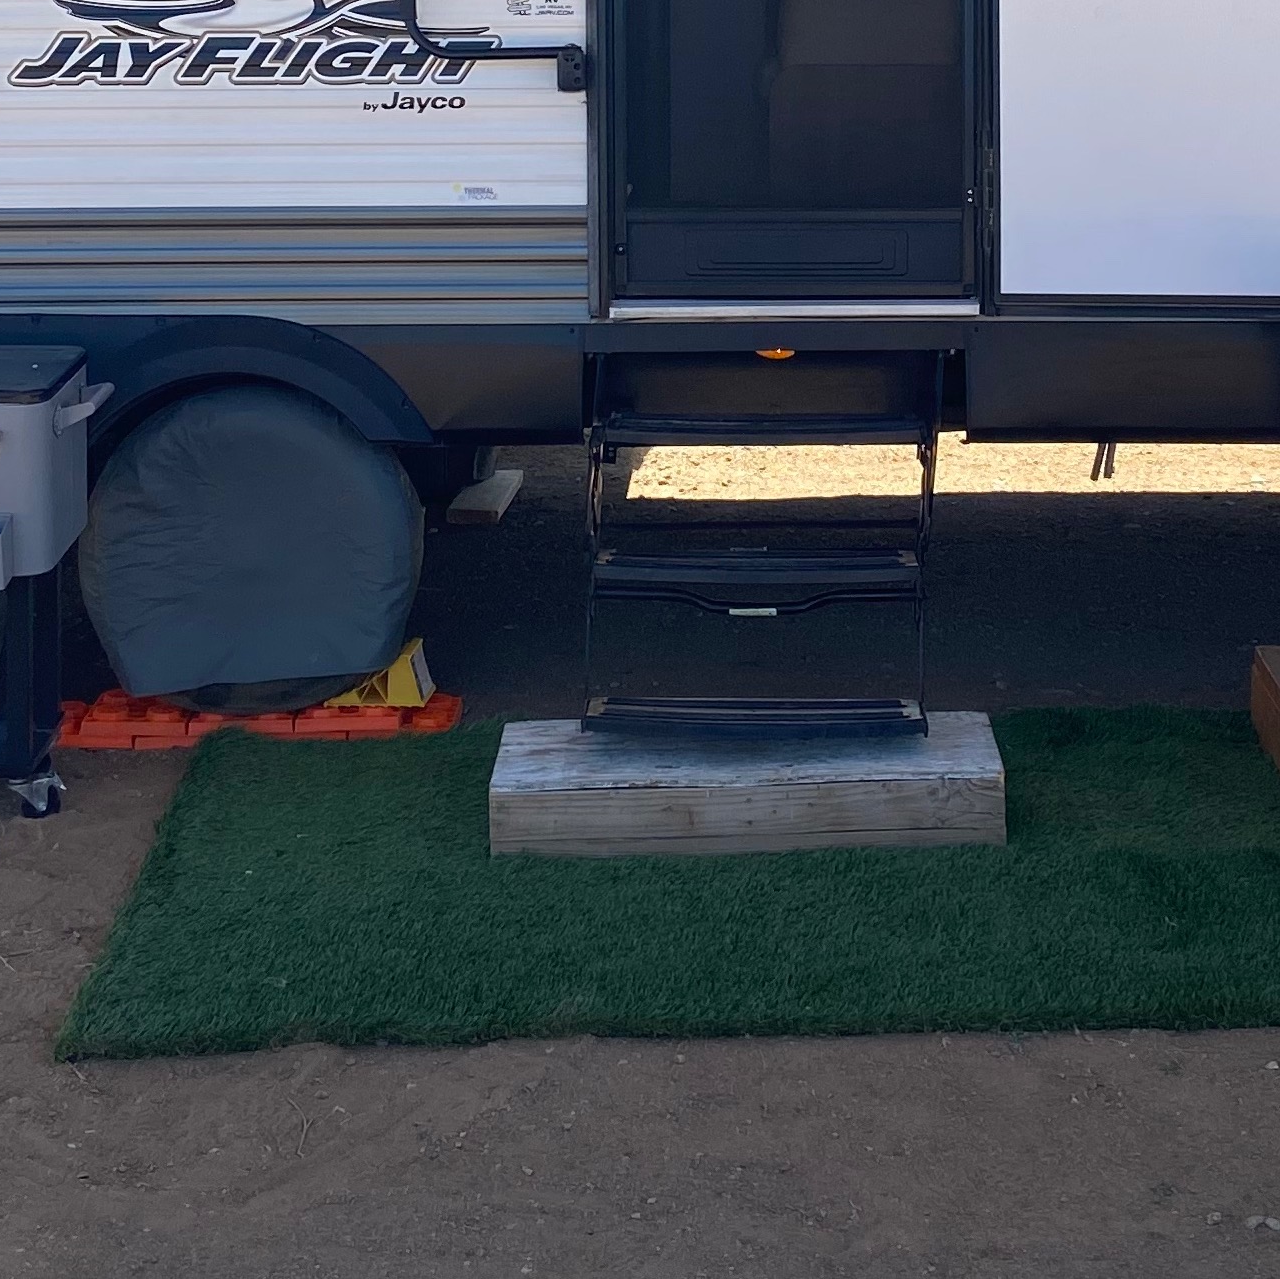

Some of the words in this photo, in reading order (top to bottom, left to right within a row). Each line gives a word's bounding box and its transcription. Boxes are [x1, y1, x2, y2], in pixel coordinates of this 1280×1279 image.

[10, 33, 190, 84] JAY
[178, 32, 499, 83] FLIGHT
[363, 102, 379, 113] by
[381, 91, 466, 114] Jayco
